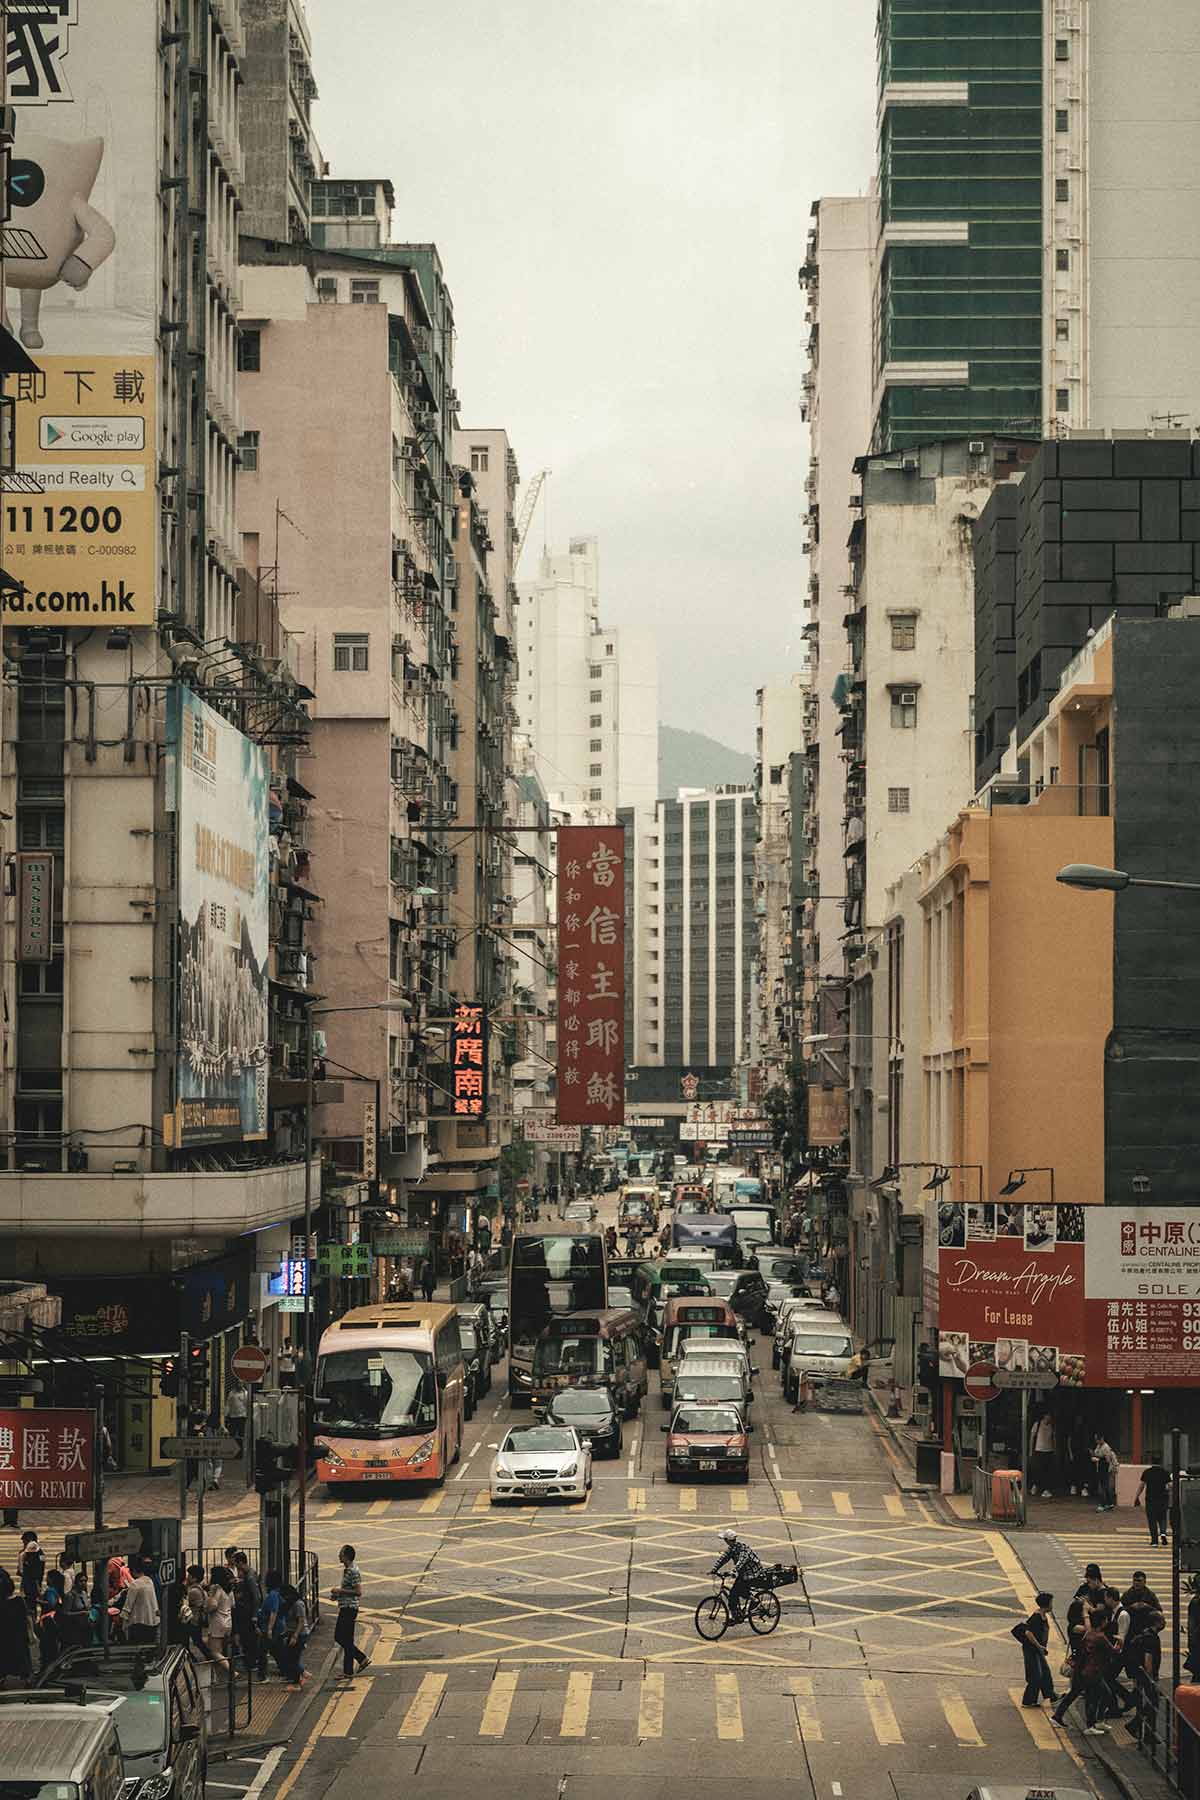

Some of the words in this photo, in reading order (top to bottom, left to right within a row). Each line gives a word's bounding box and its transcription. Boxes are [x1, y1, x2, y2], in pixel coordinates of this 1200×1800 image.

[70, 430, 113, 446] Google
[116, 430, 140, 444] play
[69, 471, 114, 487] Realty
[1140, 1246, 1200, 1257] CENTALINE
[946, 1260, 1012, 1286] Dream
[1012, 1261, 1077, 1305] Argyle
[1138, 1284, 1189, 1295] SOLE
[984, 1305, 1001, 1323] For
[1004, 1307, 1033, 1326] Lease
[1107, 1302, 1148, 1317] 潘先生
[1107, 1318, 1148, 1334] 伍小姐
[1107, 1335, 1148, 1351] 許先生
[40, 1481, 87, 1499] REMIT
